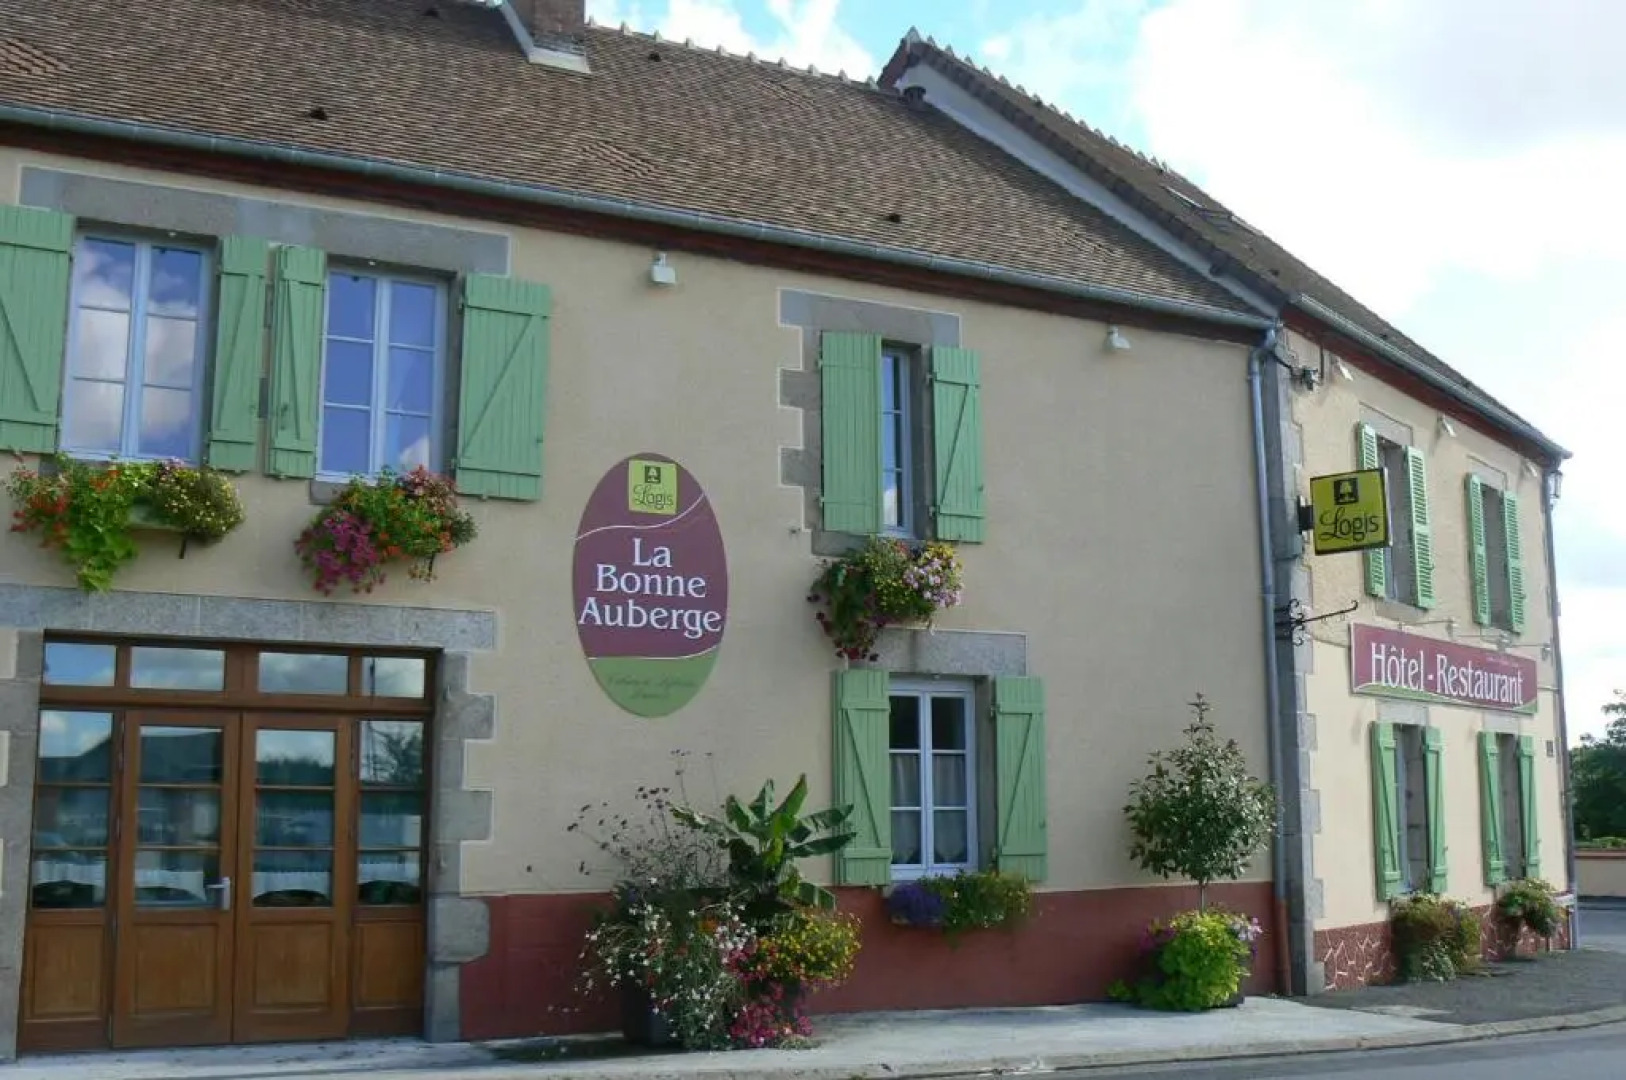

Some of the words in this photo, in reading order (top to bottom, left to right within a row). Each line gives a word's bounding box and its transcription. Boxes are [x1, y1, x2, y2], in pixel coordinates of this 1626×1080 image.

[633, 483, 674, 510] Logis
[1318, 506, 1379, 542] Logis
[632, 537, 672, 568] La
[596, 563, 706, 598] Bonne
[578, 596, 722, 640] Auberge
